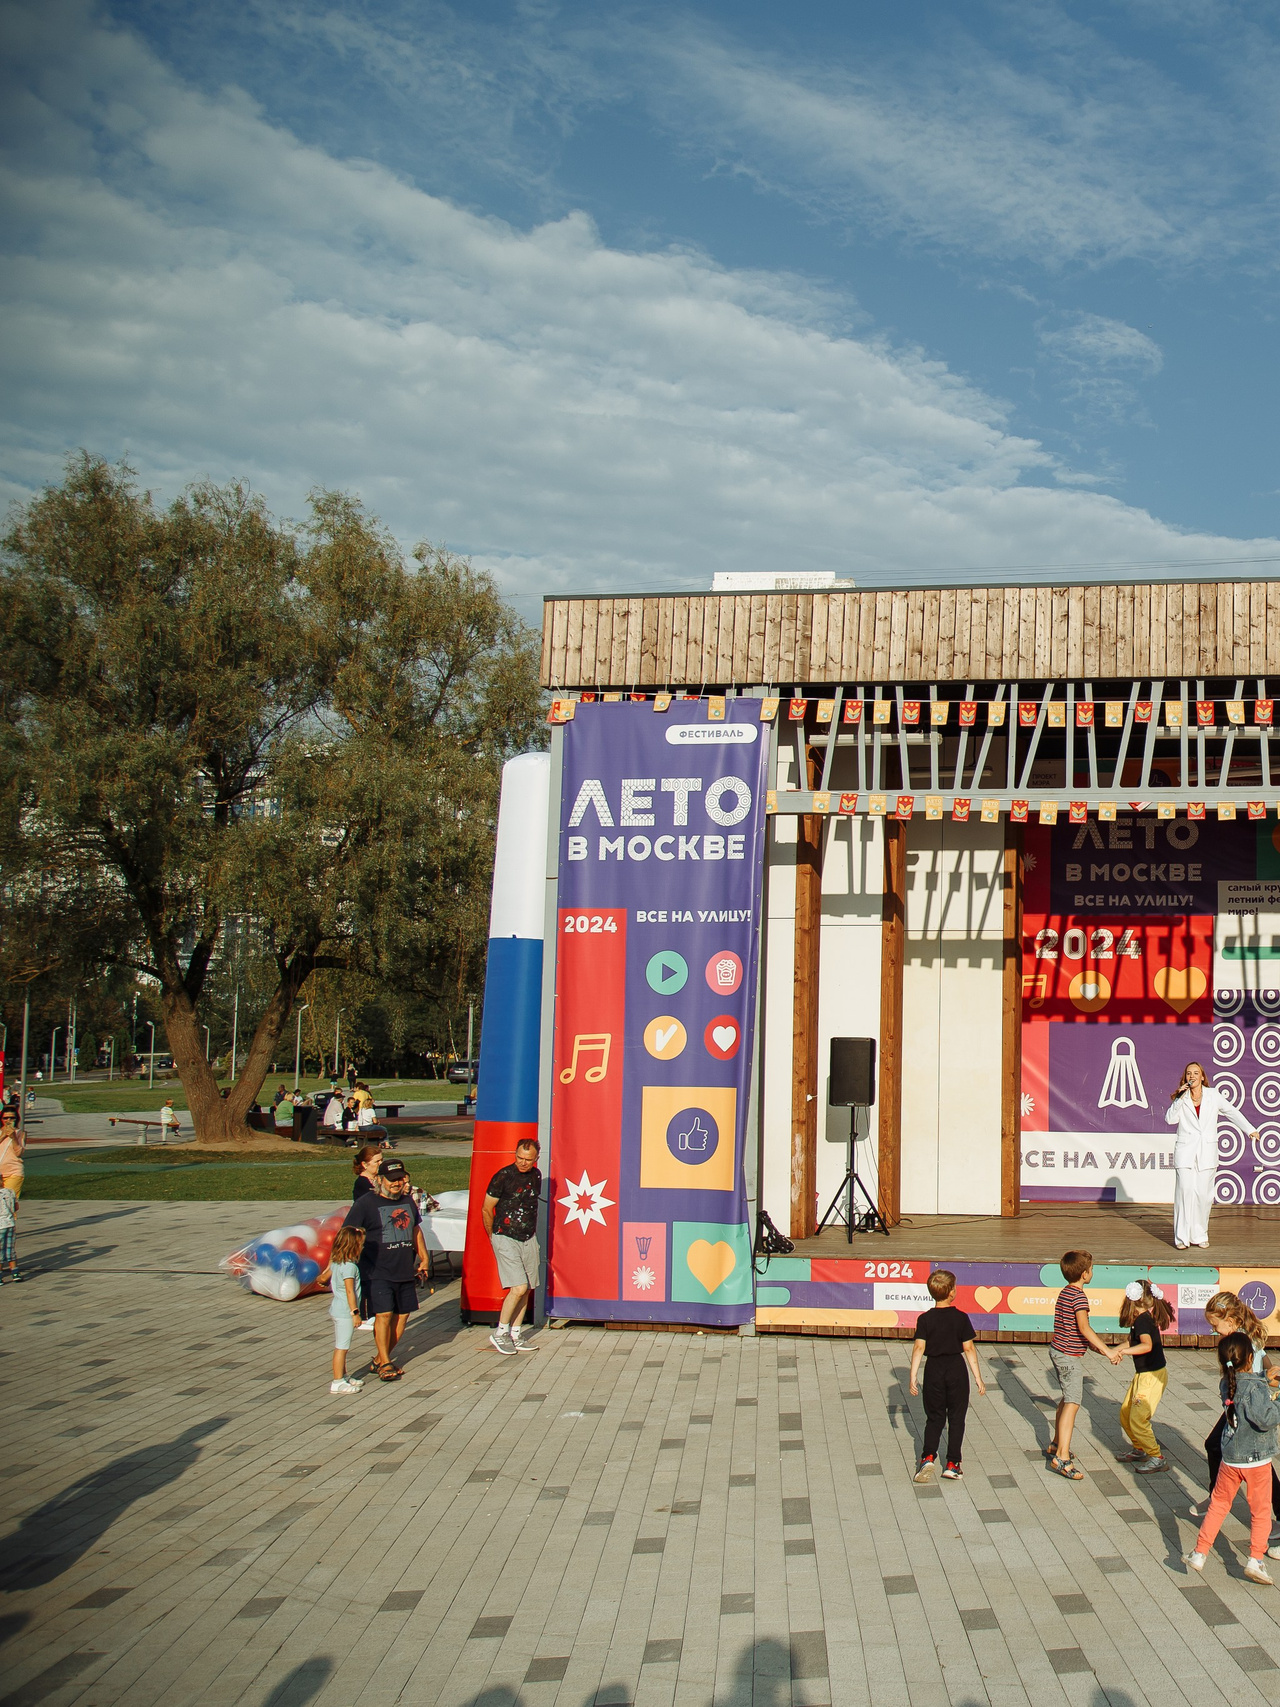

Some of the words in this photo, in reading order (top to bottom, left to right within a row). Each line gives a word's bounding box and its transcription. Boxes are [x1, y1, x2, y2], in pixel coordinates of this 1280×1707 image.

[679, 729, 744, 738] ФЕСТИВАЛЬ
[568, 776, 752, 827] ЛЕТО
[1072, 817, 1199, 850] ЛЕТО
[568, 836, 588, 861] В
[598, 834, 746, 862] МОСКВЕ
[1066, 864, 1082, 882] В
[1090, 863, 1202, 882] МОСКВЕ
[1228, 884, 1262, 892] самый
[1074, 894, 1104, 906] ВСЕ
[1108, 894, 1130, 906] НА
[1134, 894, 1194, 907] УЛИЦУ!
[1228, 895, 1264, 904] летний
[636, 910, 668, 923] ВСЕ
[671, 910, 694, 923] НА
[698, 909, 752, 923] УЛИЦУ!
[1228, 908, 1259, 917] мире!
[564, 915, 618, 934] 2024
[1036, 928, 1142, 960] 2024
[1064, 1152, 1098, 1168] НА
[1105, 1152, 1174, 1170] УЛИЦ
[864, 1262, 914, 1278] 2024
